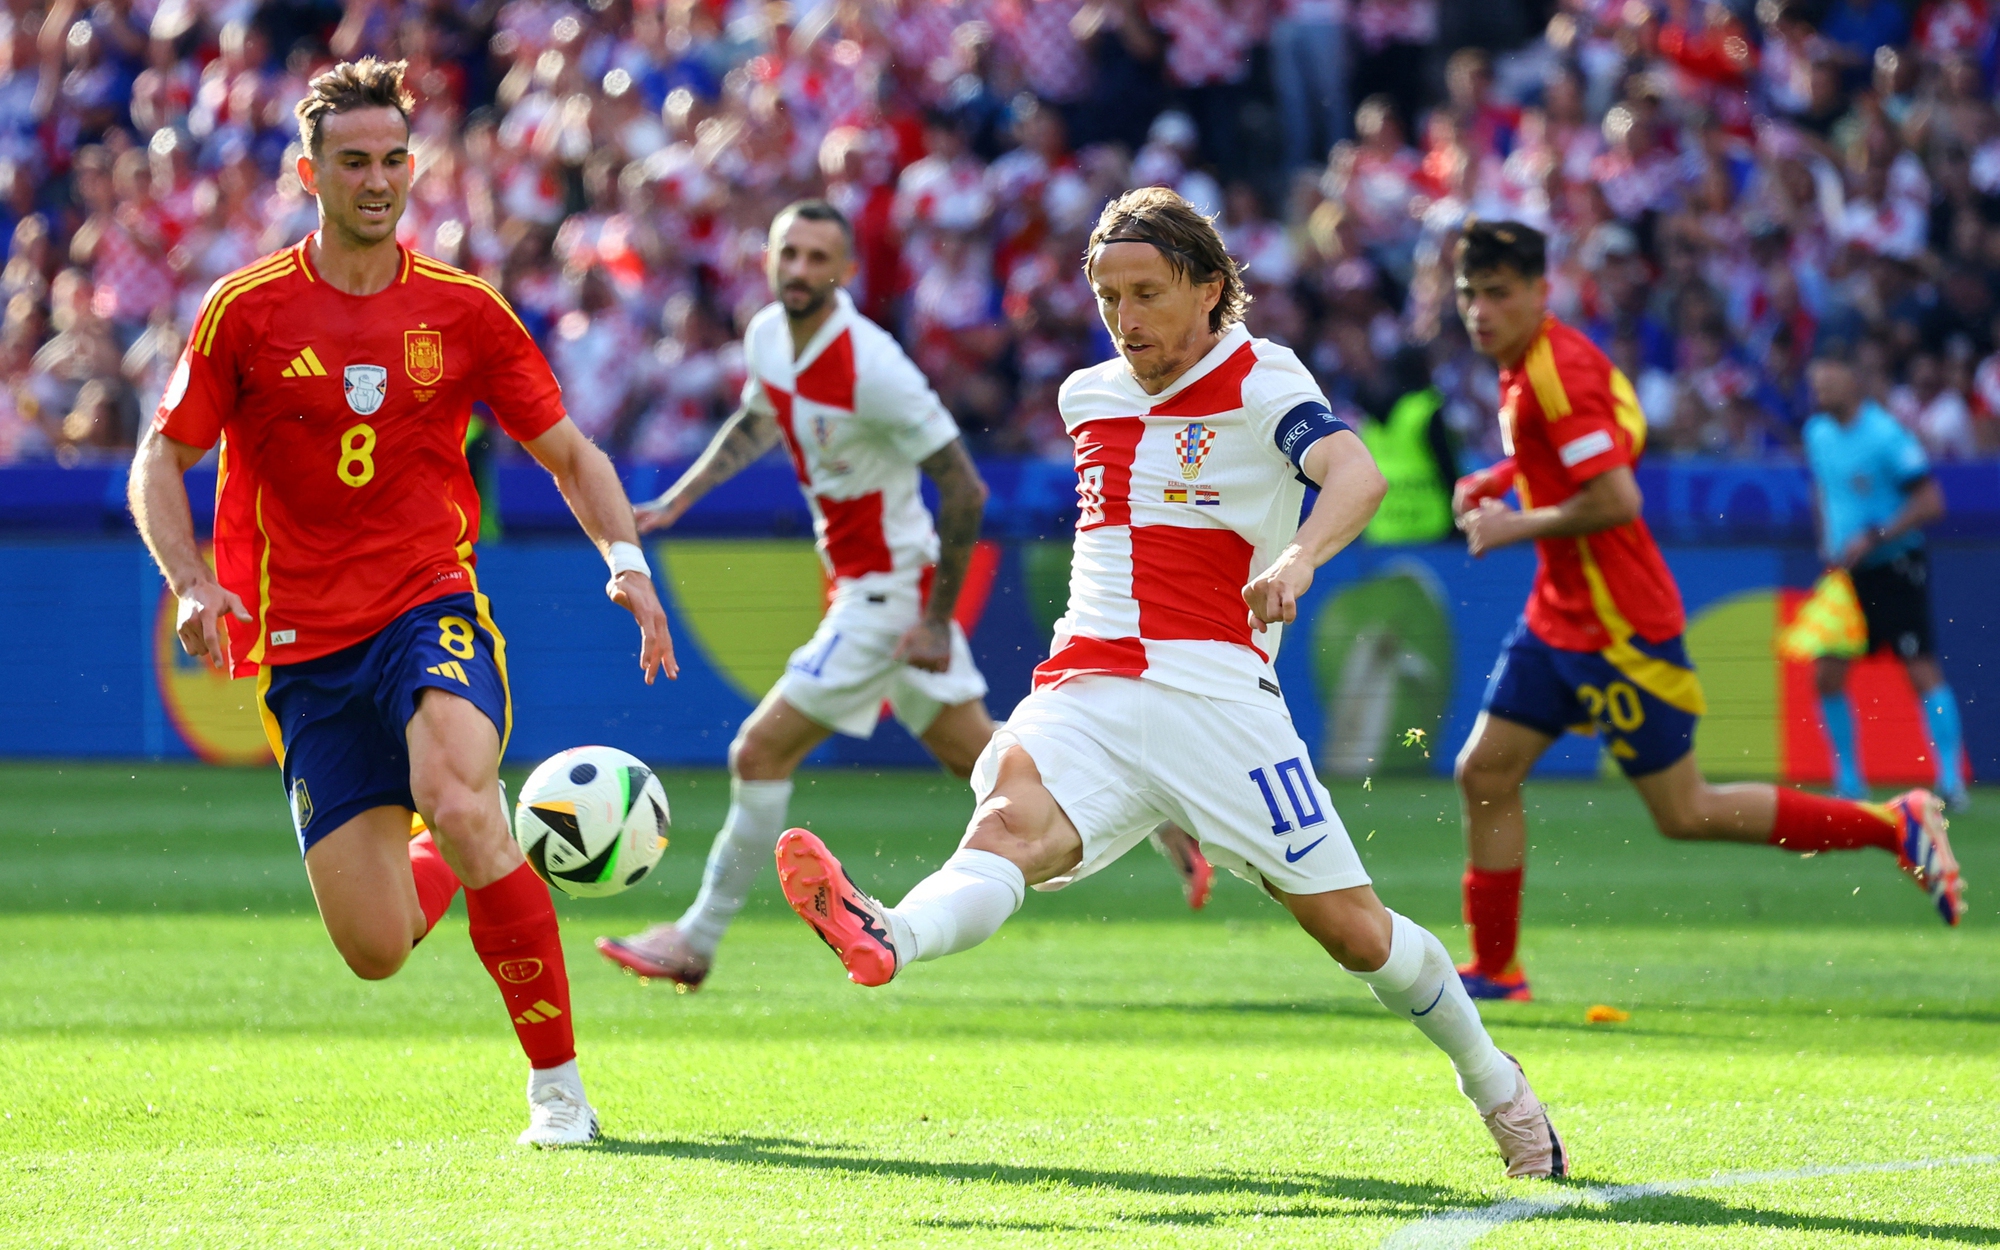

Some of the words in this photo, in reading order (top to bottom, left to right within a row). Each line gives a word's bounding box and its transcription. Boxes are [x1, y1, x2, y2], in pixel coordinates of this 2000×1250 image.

[337, 423, 377, 488] 8
[1284, 421, 1309, 454] SPECT
[438, 615, 475, 660] 8
[1248, 757, 1327, 837] 10
